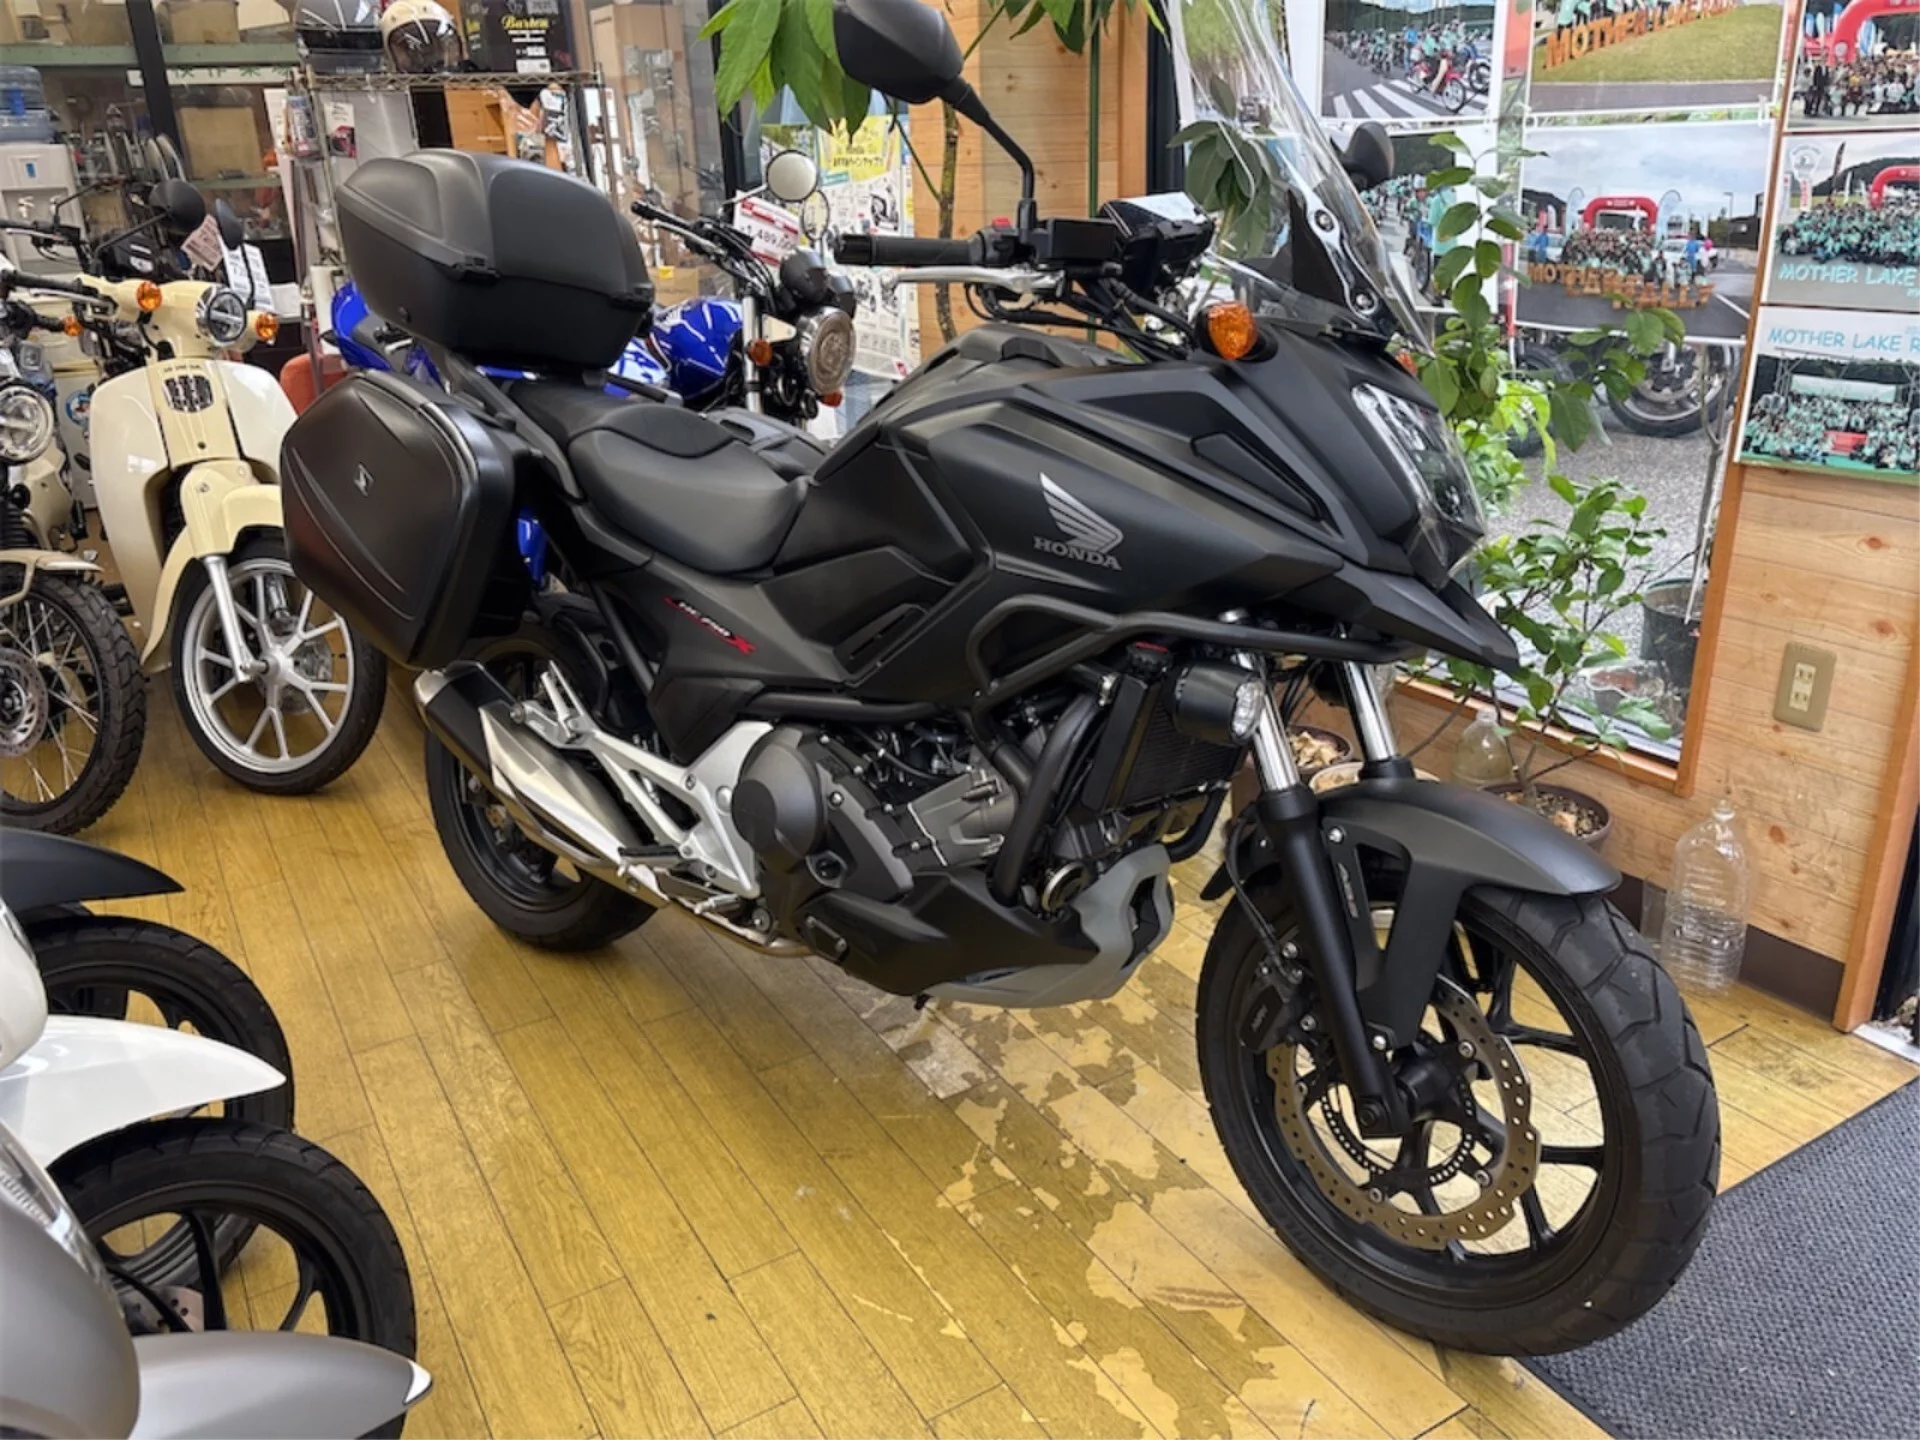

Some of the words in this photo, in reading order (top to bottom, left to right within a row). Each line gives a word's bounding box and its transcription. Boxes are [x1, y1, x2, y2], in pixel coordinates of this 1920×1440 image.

[1779, 263, 1858, 285] MOTHER
[1865, 266, 1917, 287] LAKE
[1768, 327, 1845, 348] MOTHER
[1852, 333, 1902, 351] LAKE
[1033, 535, 1122, 571] HONDA
